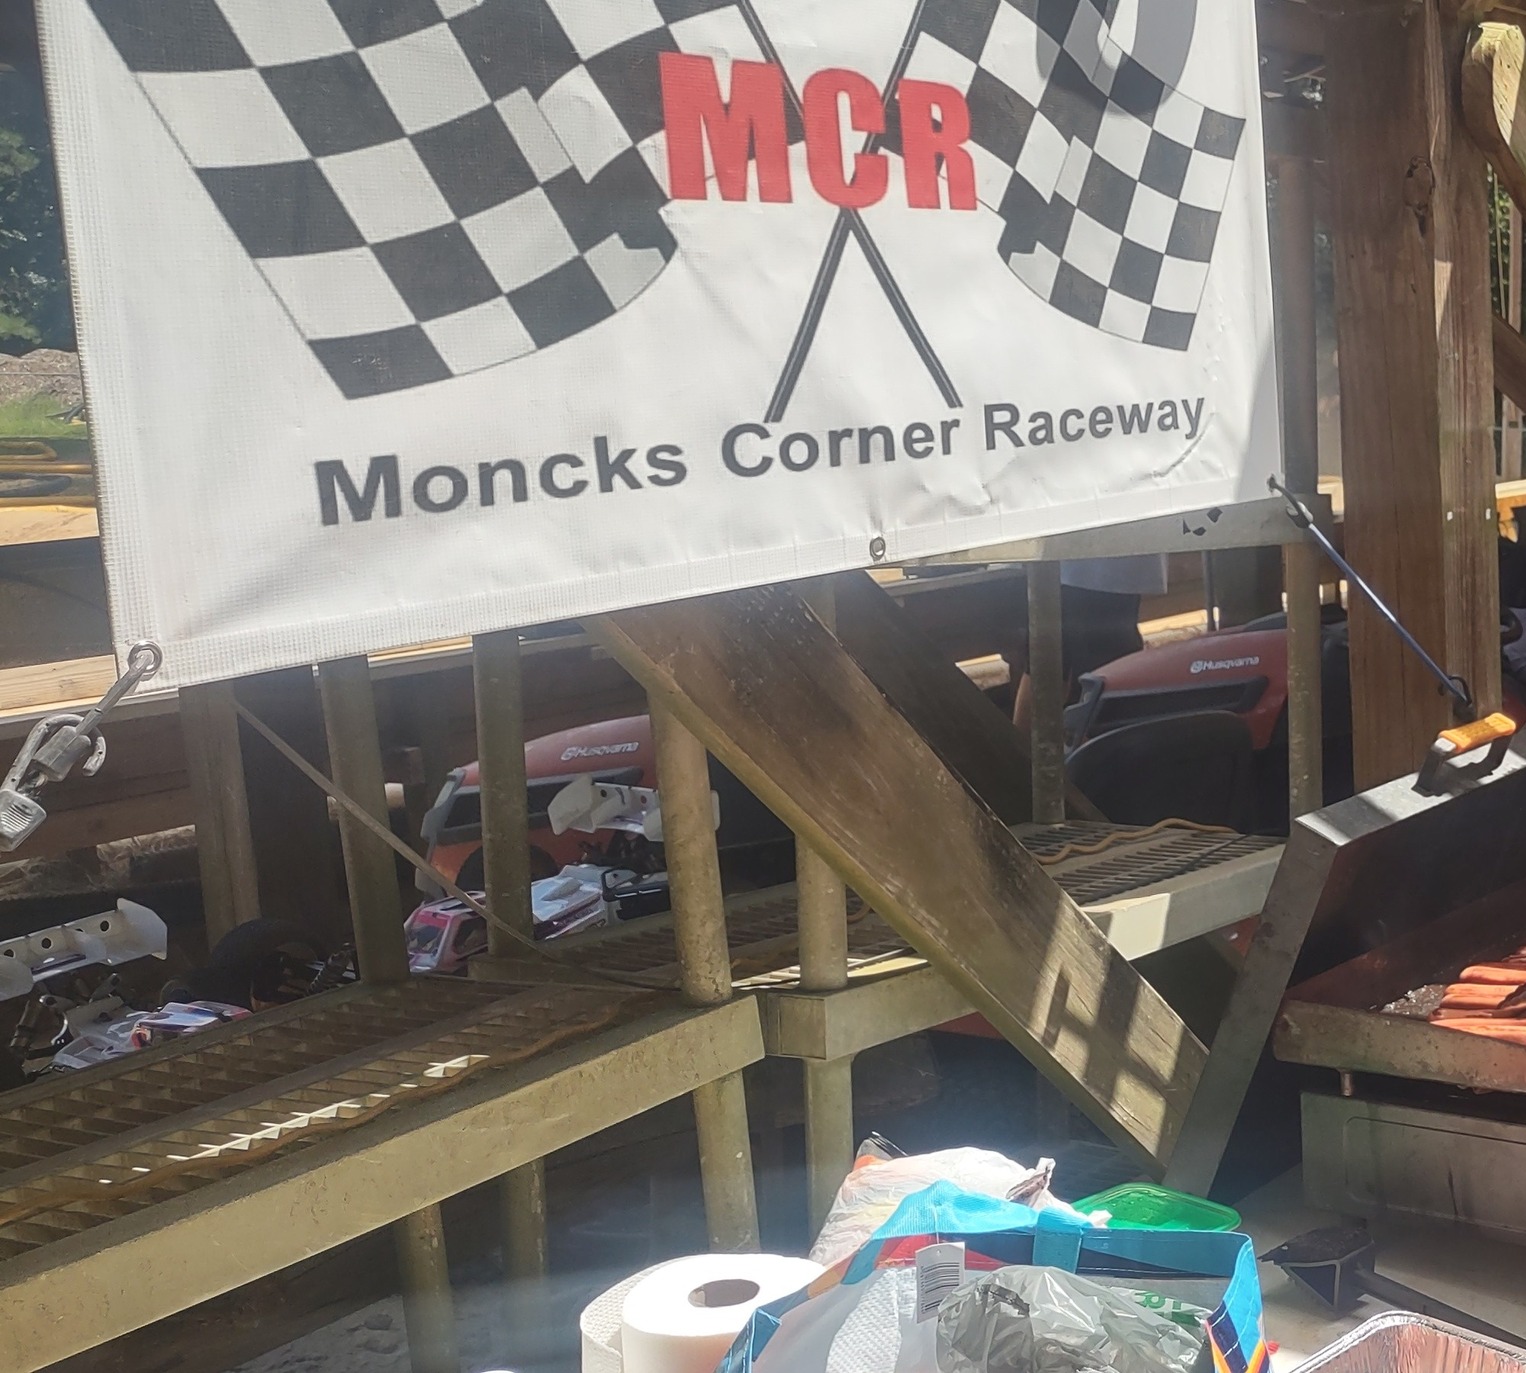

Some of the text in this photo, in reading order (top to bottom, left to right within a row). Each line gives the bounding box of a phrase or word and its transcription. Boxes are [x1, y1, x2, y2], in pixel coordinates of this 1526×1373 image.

[659, 51, 977, 211] MCR
[315, 397, 1205, 526] Moncks Corner Raceway
[1203, 656, 1259, 670] Husqvarna
